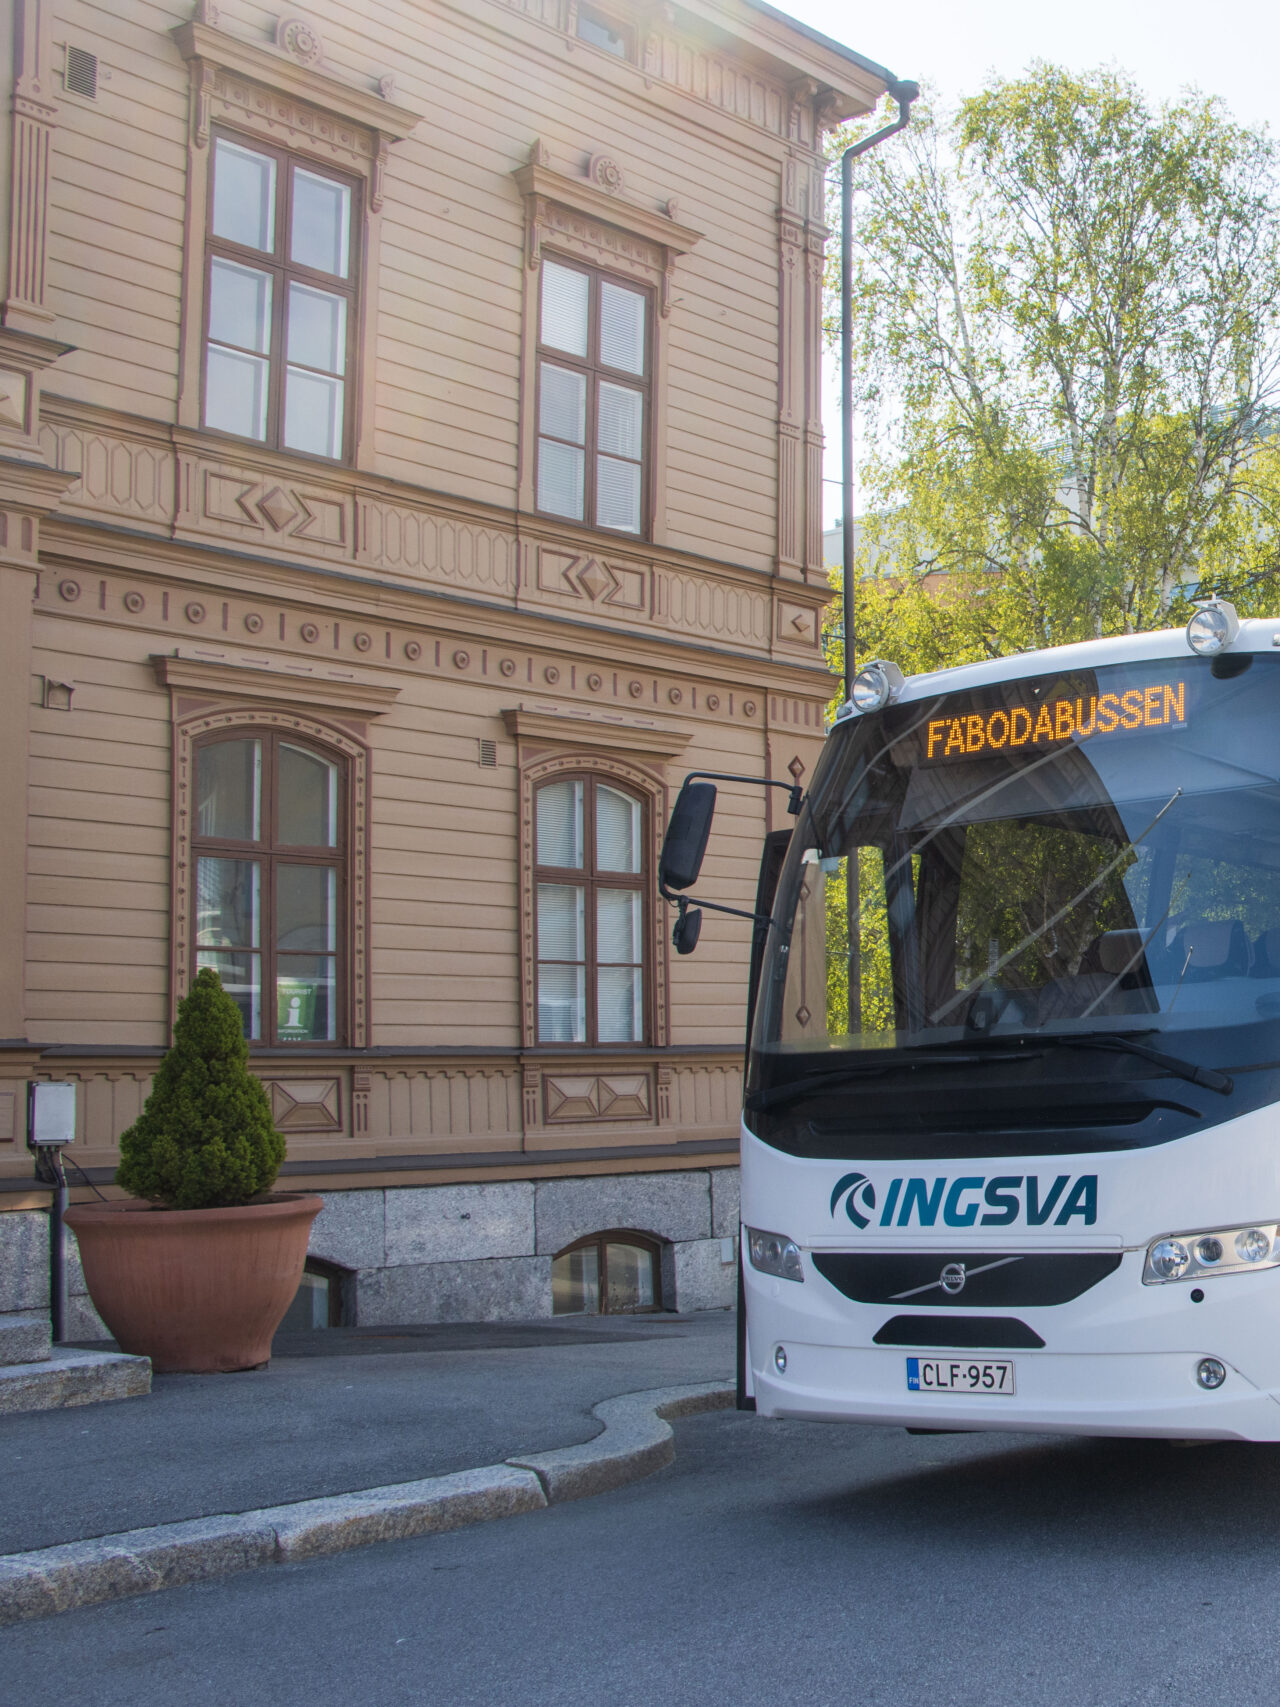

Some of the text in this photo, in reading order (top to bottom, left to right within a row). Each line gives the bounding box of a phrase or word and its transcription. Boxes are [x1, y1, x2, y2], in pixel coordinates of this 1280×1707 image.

[927, 682, 1185, 758] FÄBODABUSSEN
[879, 1175, 1098, 1227] INGSVA
[908, 1376, 919, 1385] FIN
